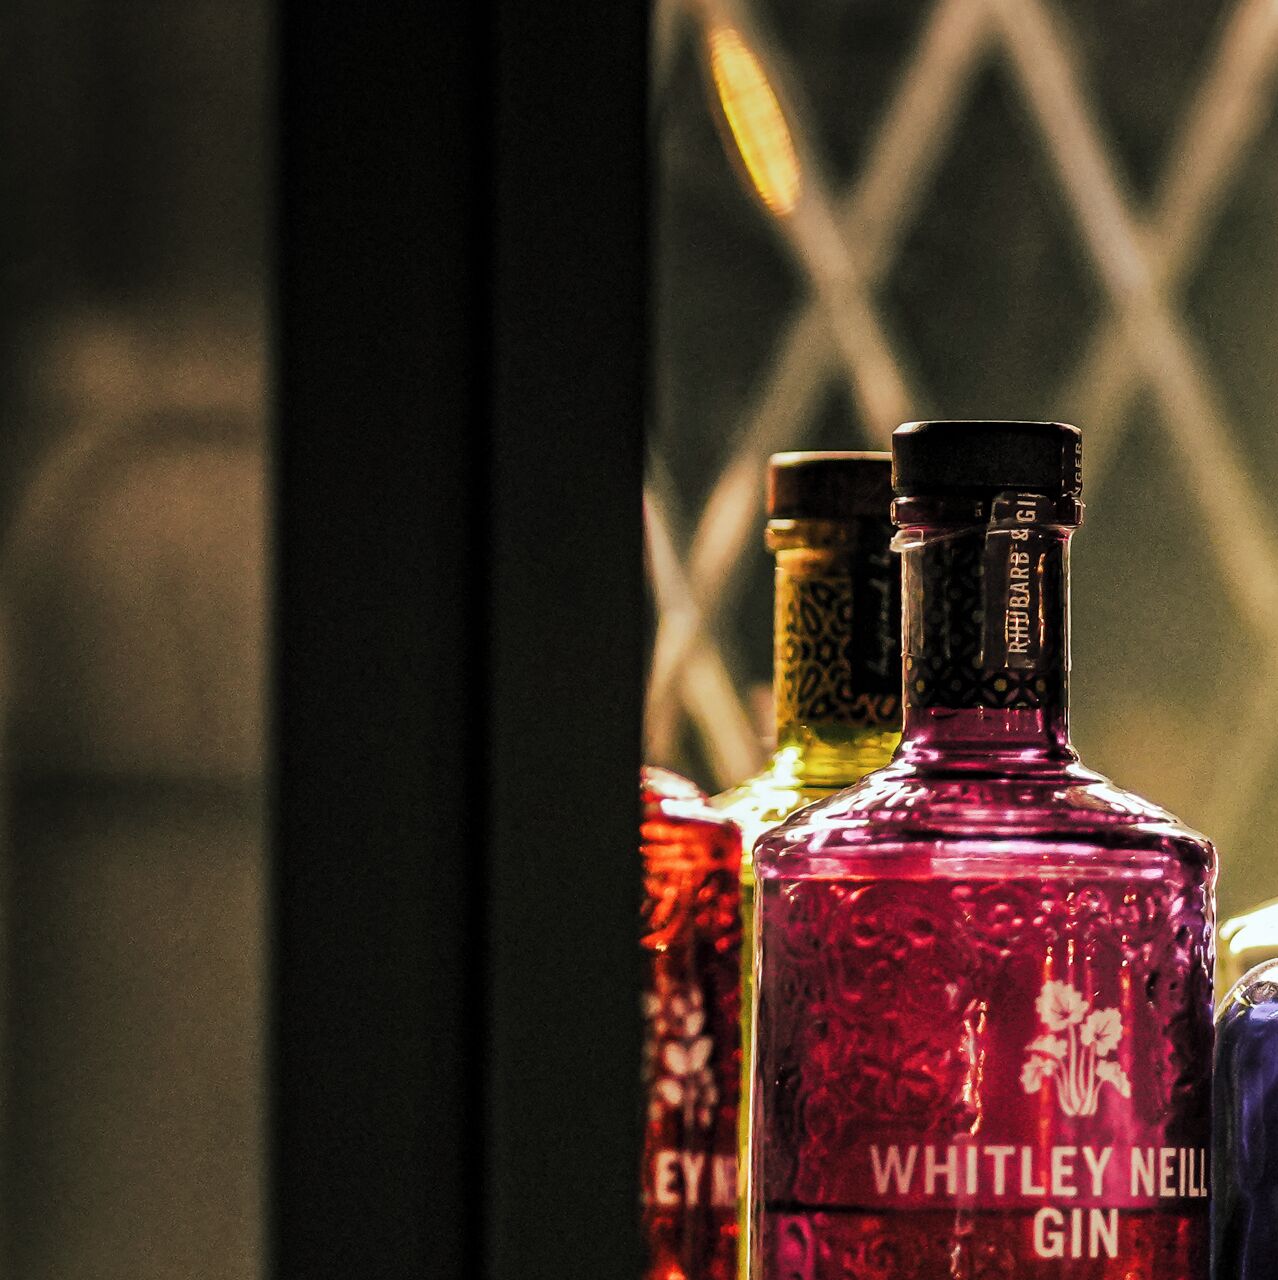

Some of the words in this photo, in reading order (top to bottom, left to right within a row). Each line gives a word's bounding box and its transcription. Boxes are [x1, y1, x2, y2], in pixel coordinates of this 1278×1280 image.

[1007, 552, 1030, 654] RHUBARB
[869, 1143, 1113, 1198] WHITLEY
[1129, 1145, 1209, 1198] NEILL
[1032, 1207, 1120, 1259] GIN
